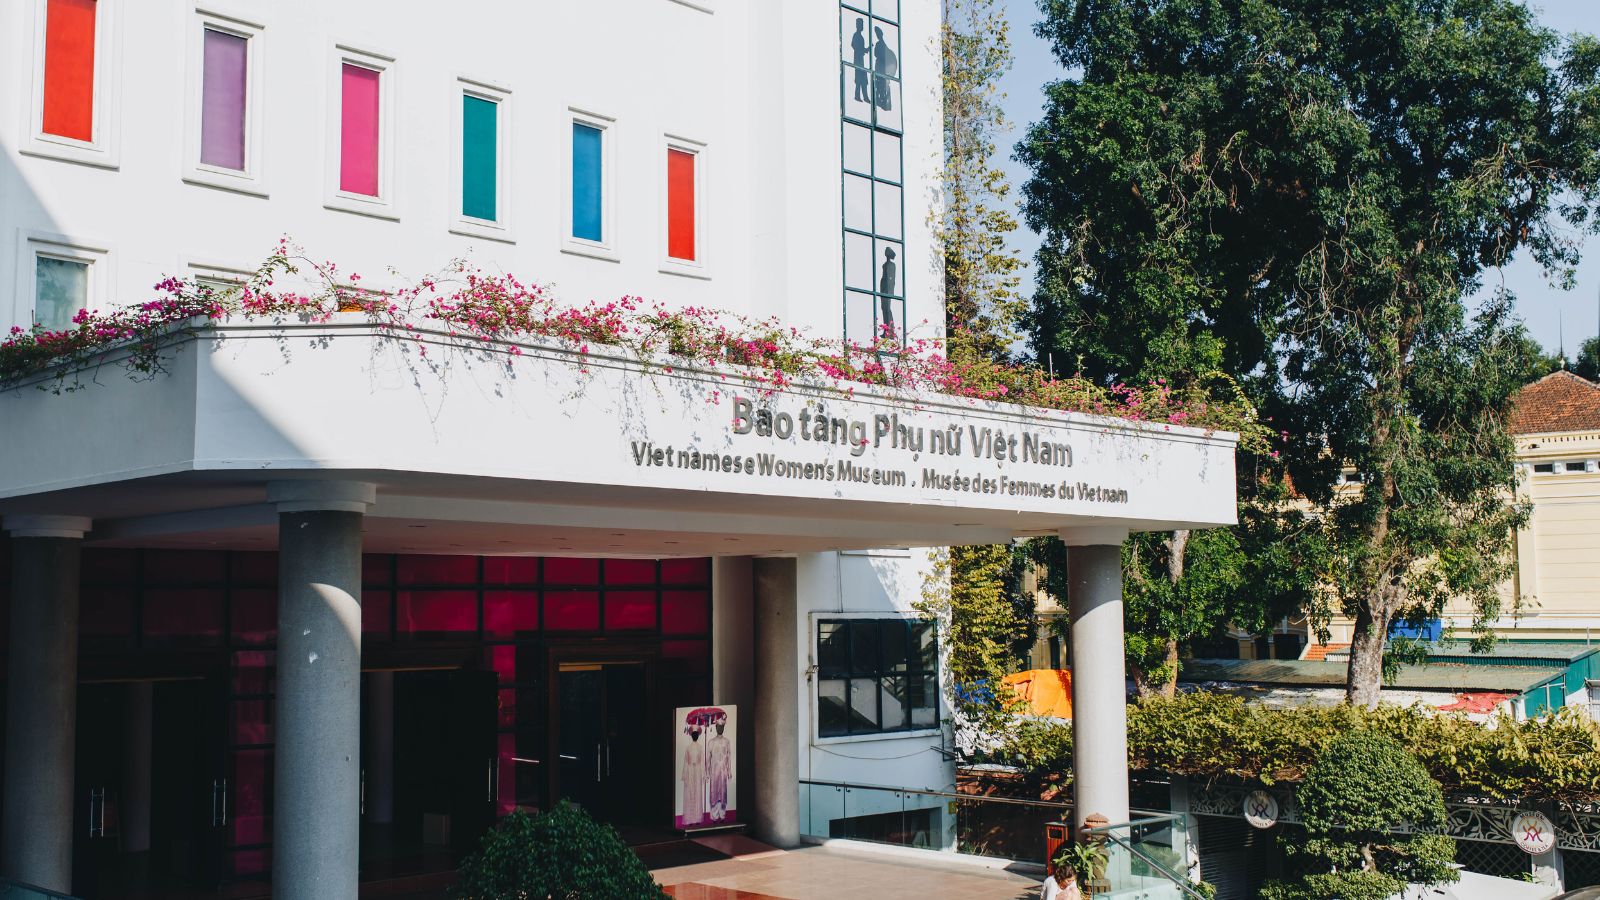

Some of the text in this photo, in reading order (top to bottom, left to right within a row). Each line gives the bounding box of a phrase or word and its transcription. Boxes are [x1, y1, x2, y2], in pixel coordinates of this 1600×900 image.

[799, 402, 867, 457] tàng
[873, 412, 924, 462] Phụ
[930, 423, 963, 456] nữ
[968, 424, 1018, 470] Việt
[1022, 431, 1074, 468] Nam
[757, 452, 835, 482] Women's
[837, 459, 906, 487] Museum
[921, 468, 970, 492] Musée
[972, 472, 998, 495] des
[999, 475, 1056, 499] Femmes
[1058, 480, 1075, 501] du
[1076, 481, 1129, 504] Vietnam
